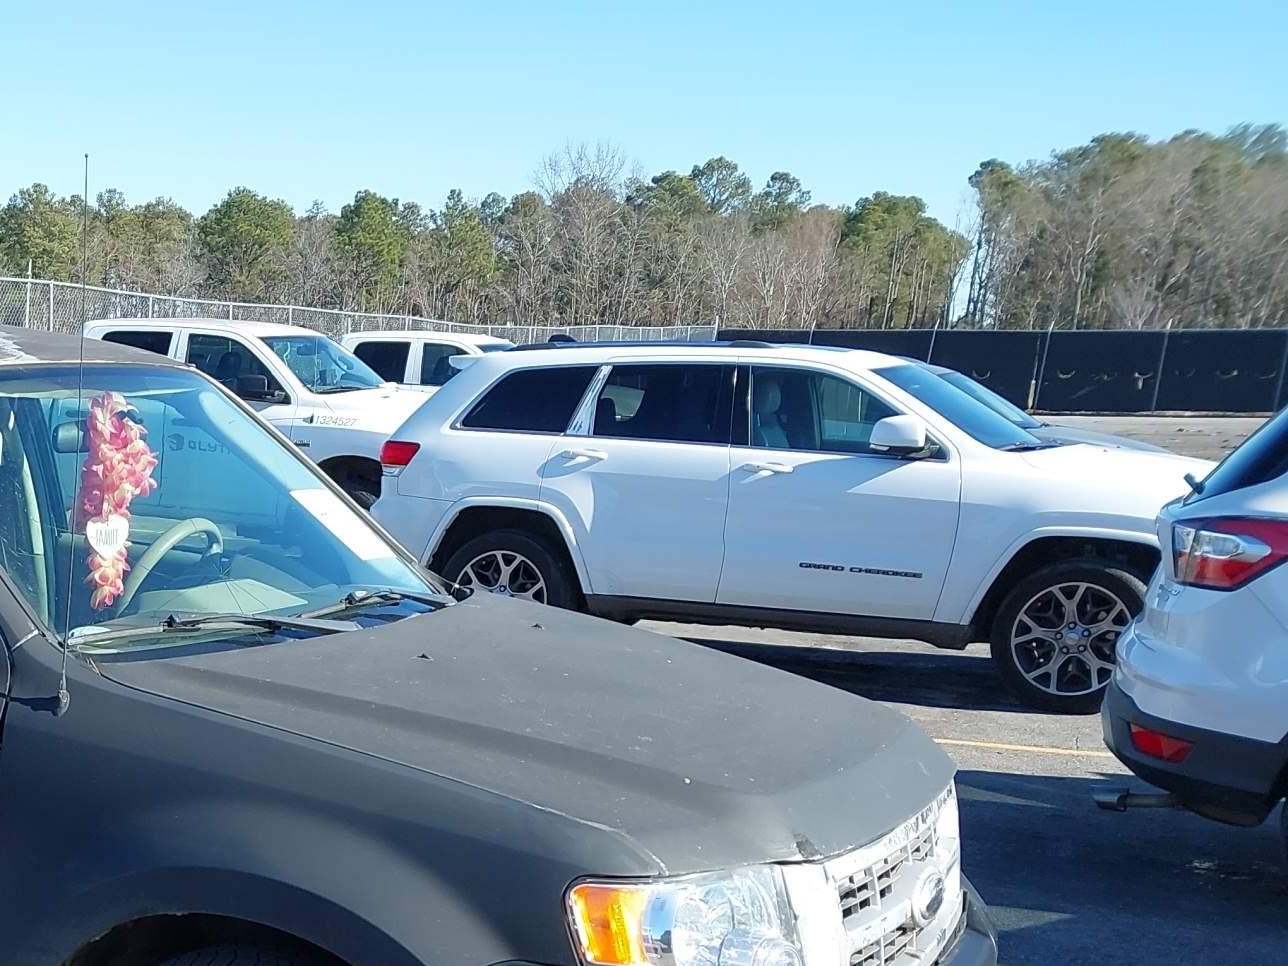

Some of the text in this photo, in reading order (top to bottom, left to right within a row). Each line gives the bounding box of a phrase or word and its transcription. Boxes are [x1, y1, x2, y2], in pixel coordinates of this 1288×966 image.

[315, 415, 357, 427] 1324527
[799, 562, 923, 579] GRAND CHEROKEE
